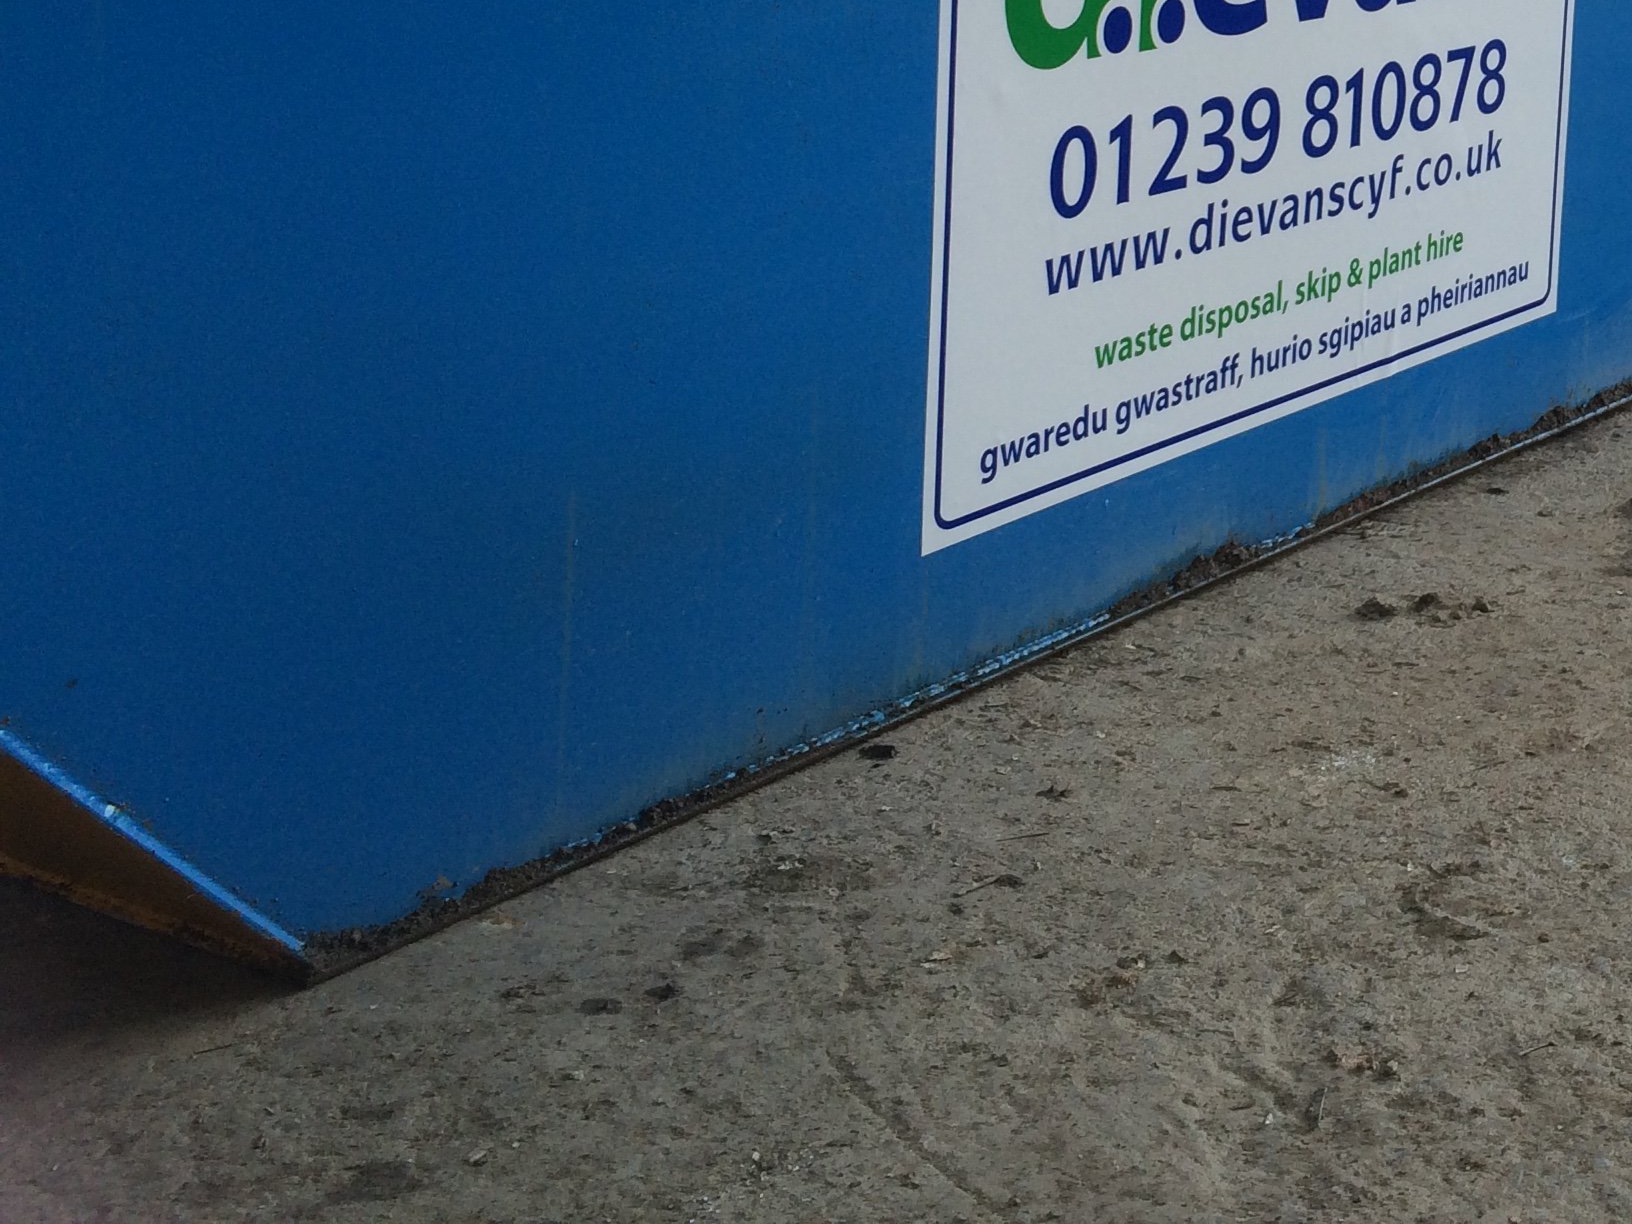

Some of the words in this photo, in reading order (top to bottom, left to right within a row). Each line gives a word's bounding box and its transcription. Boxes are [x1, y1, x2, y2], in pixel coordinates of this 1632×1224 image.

[1044, 129, 1503, 296] www.dievanscyf.co.uk
[1049, 87, 1281, 219] 01239
[1301, 38, 1507, 159] 810878
[979, 403, 1108, 485] gwaredu
[1114, 352, 1244, 436] gwastraff,
[1250, 333, 1313, 379] hurio
[1317, 308, 1396, 359] sgipiau
[1400, 302, 1412, 325] a
[1416, 260, 1530, 326] pheiriannau
[1094, 322, 1174, 369] waste
[1179, 279, 1290, 338] disposal,
[1294, 267, 1342, 302] skip
[1346, 257, 1364, 288] &
[1367, 241, 1422, 289] plant
[1426, 229, 1465, 262] hire
